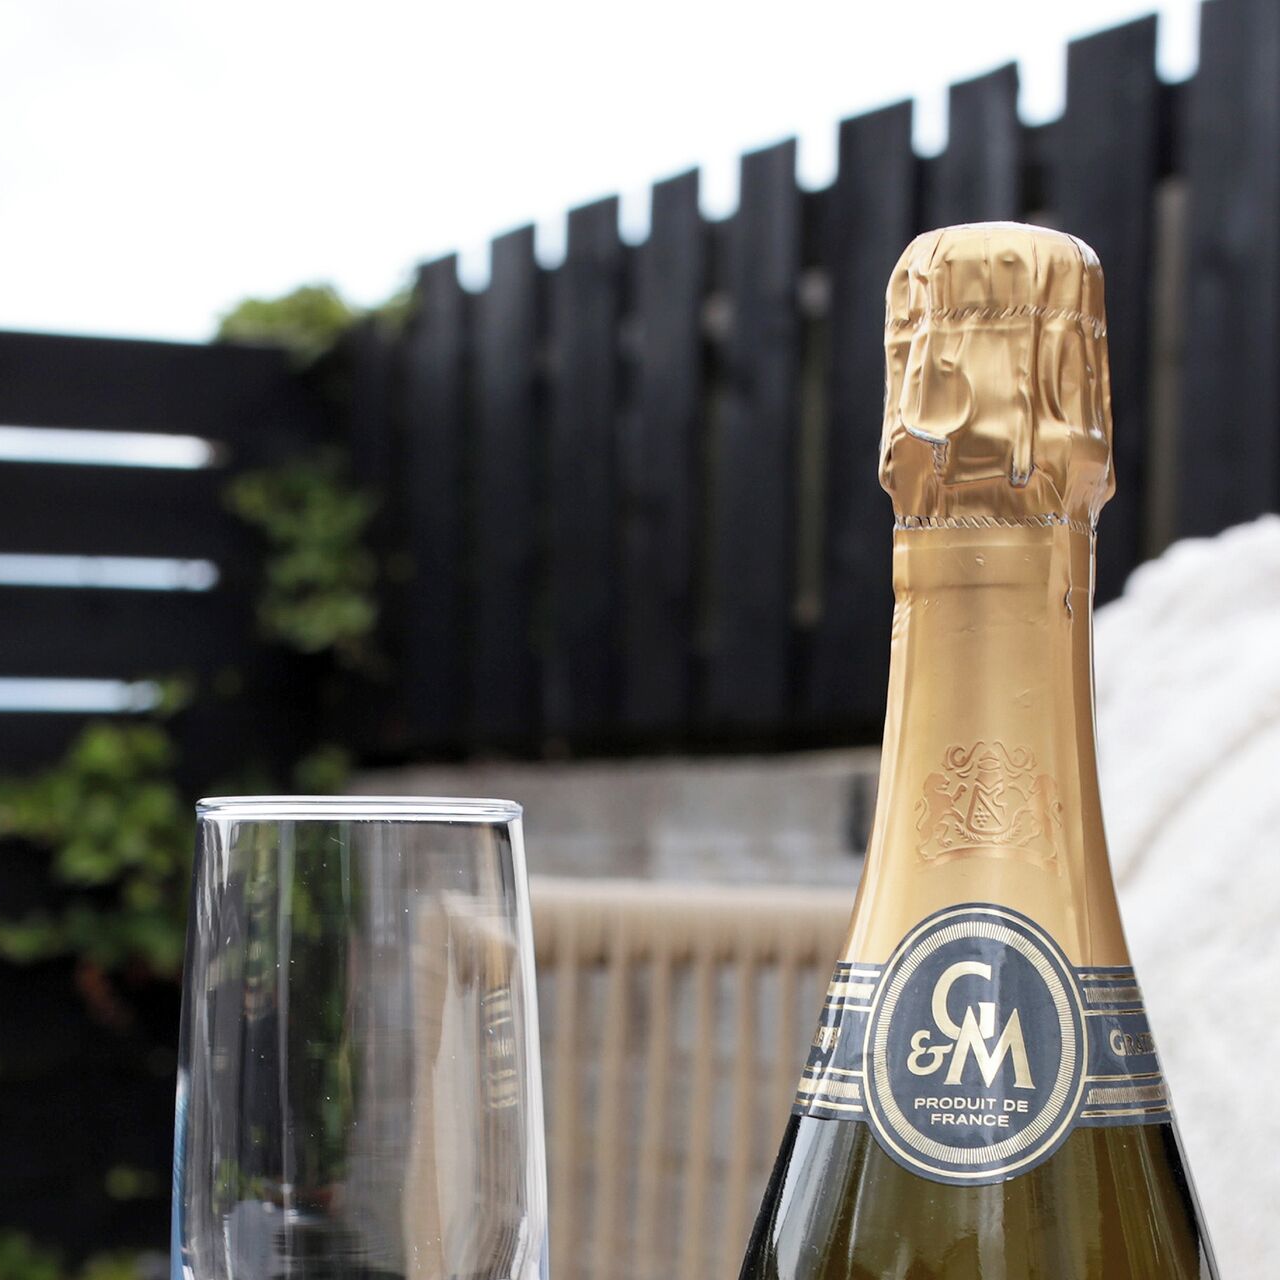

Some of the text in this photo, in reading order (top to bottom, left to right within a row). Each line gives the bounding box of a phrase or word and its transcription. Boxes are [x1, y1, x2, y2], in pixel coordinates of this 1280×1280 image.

[914, 1097, 1029, 1113] PRODUIT DE
[930, 1113, 1010, 1128] FRANCE
